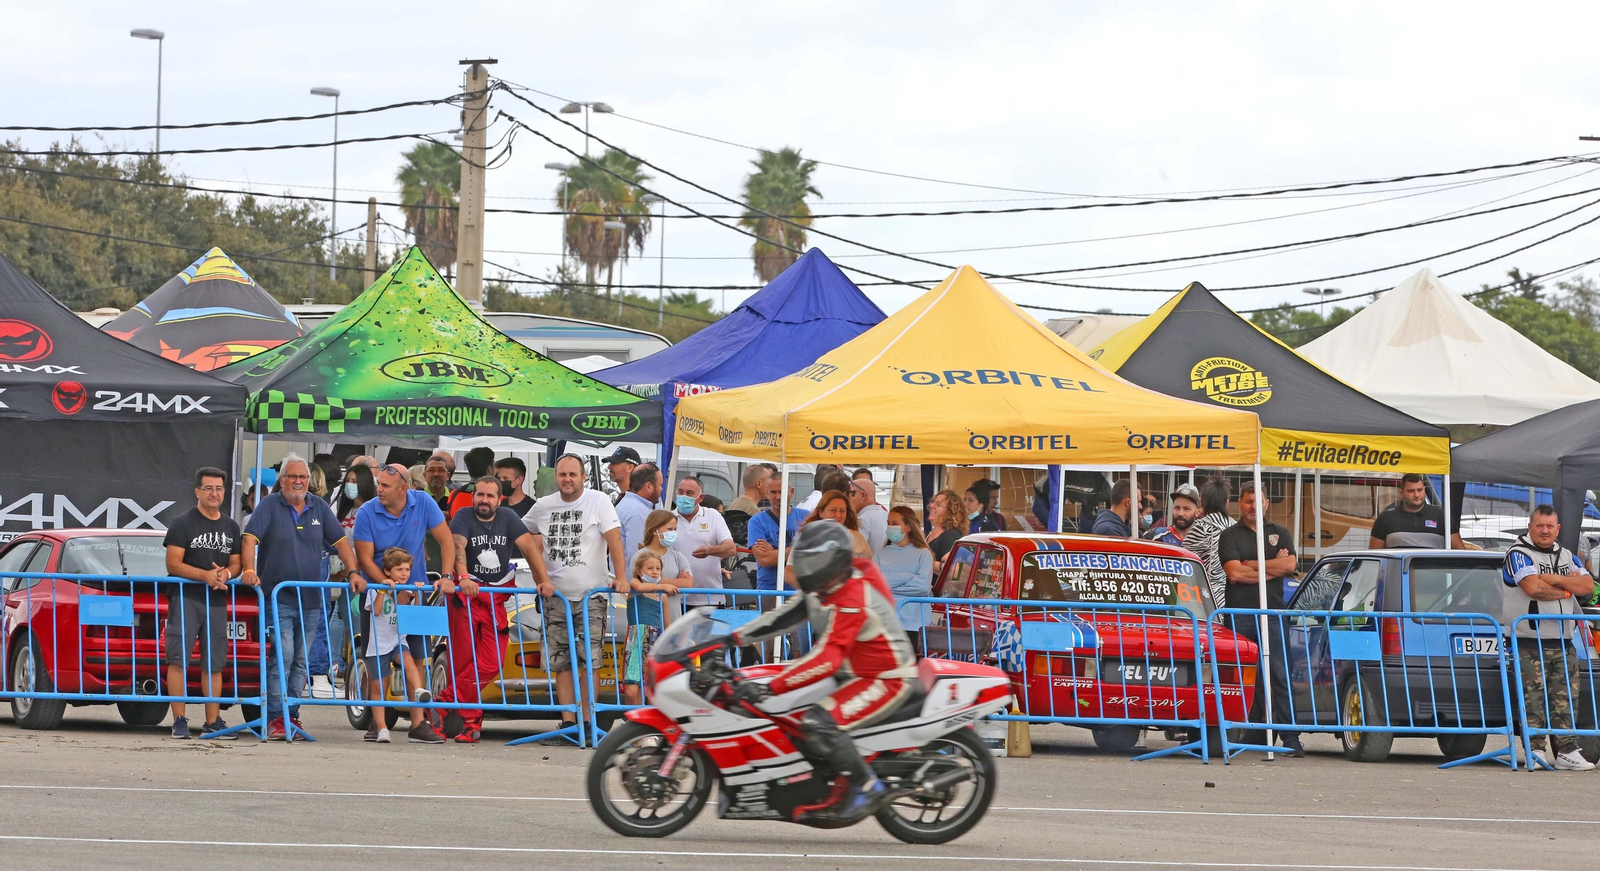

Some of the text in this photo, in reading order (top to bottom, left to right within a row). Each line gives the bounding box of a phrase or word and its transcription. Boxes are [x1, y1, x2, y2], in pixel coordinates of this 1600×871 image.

[402, 361, 489, 385] JBM
[1195, 359, 1248, 378] ANTI-FRICTION
[901, 370, 1108, 393] ORBITEL
[1191, 372, 1267, 391] METAL
[1207, 380, 1268, 396] LUBE
[93, 391, 212, 414] 24MX
[1218, 392, 1268, 405] TREATMENT
[375, 406, 549, 429] PROFESSIONAL TOOLS
[582, 415, 628, 430] JBM
[679, 416, 705, 436] ORBITEL
[753, 431, 778, 447] ORBITEL
[809, 434, 919, 450] ORBITEL
[968, 434, 1078, 450] ORBITEL
[1127, 433, 1236, 450] ORBITEL
[1277, 440, 1402, 467] #EvitaelRoce
[0, 492, 176, 530] 4MX
[1035, 554, 1193, 577] TALLERES BANCALERO
[1056, 571, 1088, 580] CHAPA,
[1090, 572, 1125, 580] PINTURA
[1136, 574, 1179, 583] MECANICA
[1094, 580, 1118, 592] 956
[1121, 582, 1145, 594] 420
[1148, 583, 1171, 596] 678
[1176, 583, 1203, 604] 61
[1079, 593, 1104, 601] ALCALA
[1119, 594, 1132, 602] LOS
[1135, 595, 1165, 604] GAZULES
[226, 623, 245, 637] HC
[601, 649, 620, 659] avi
[1106, 696, 1140, 706] BAR
